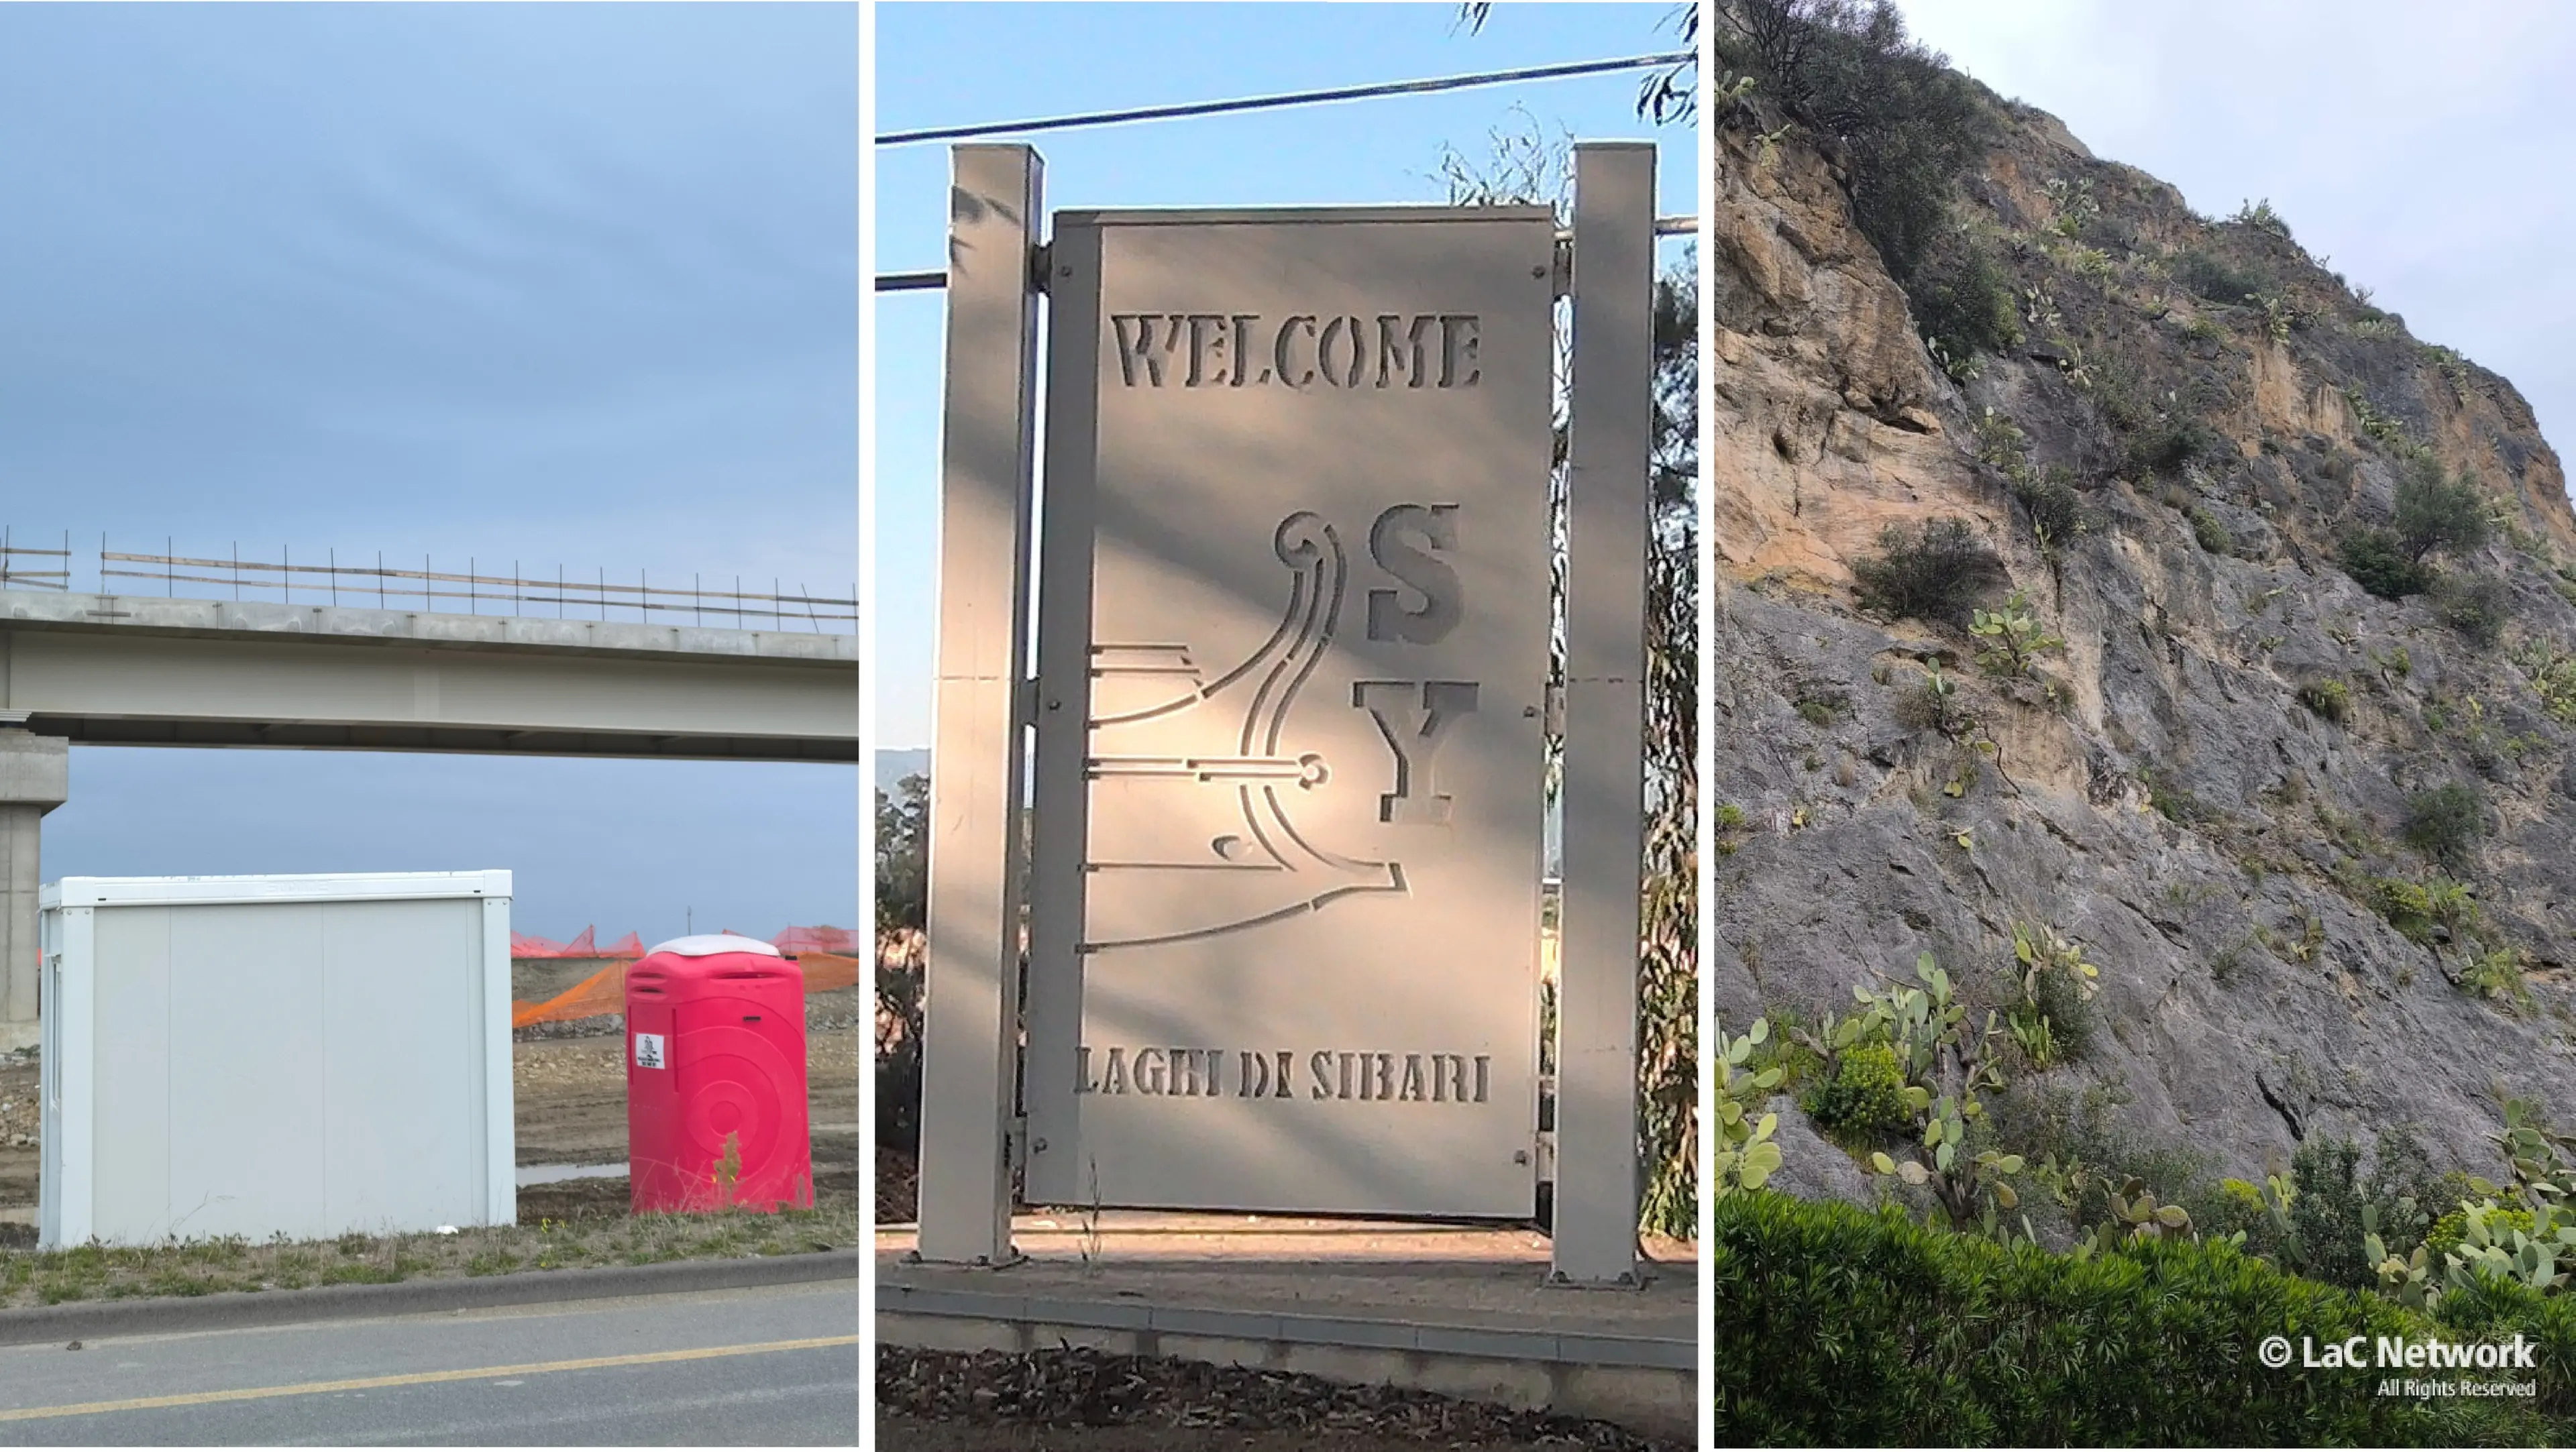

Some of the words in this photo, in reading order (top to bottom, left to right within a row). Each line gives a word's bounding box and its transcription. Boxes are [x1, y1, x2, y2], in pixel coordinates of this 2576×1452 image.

[1111, 313, 1480, 388] WELCOME
[1073, 1046, 1224, 1096] LAGHI
[1238, 1051, 1293, 1098] DI
[1310, 1050, 1491, 1102] SIBARI
